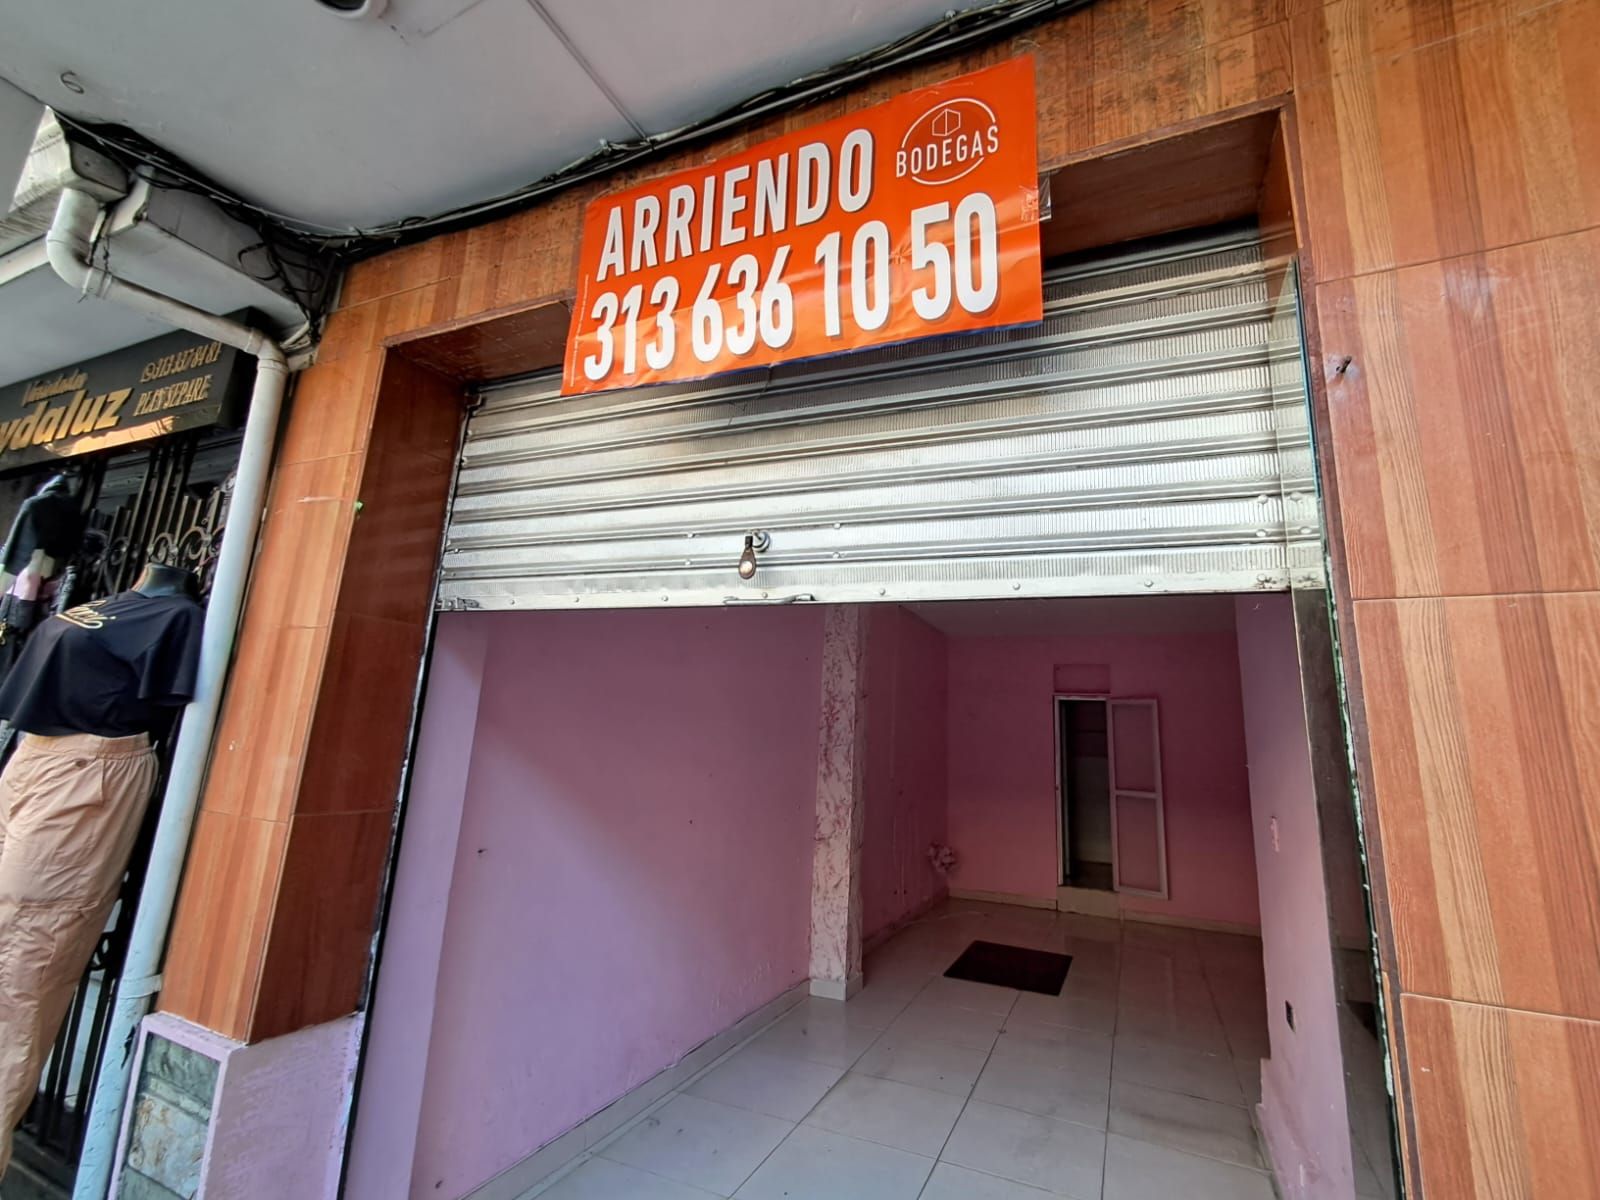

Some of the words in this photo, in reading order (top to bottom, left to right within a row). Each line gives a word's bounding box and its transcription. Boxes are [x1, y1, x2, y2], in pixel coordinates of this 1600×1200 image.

[596, 128, 873, 282] ARRIENDO
[896, 126, 999, 178] BODEGAS
[584, 276, 680, 381] 313
[692, 245, 794, 363] 636
[814, 220, 890, 337] 10
[911, 192, 998, 320] 50
